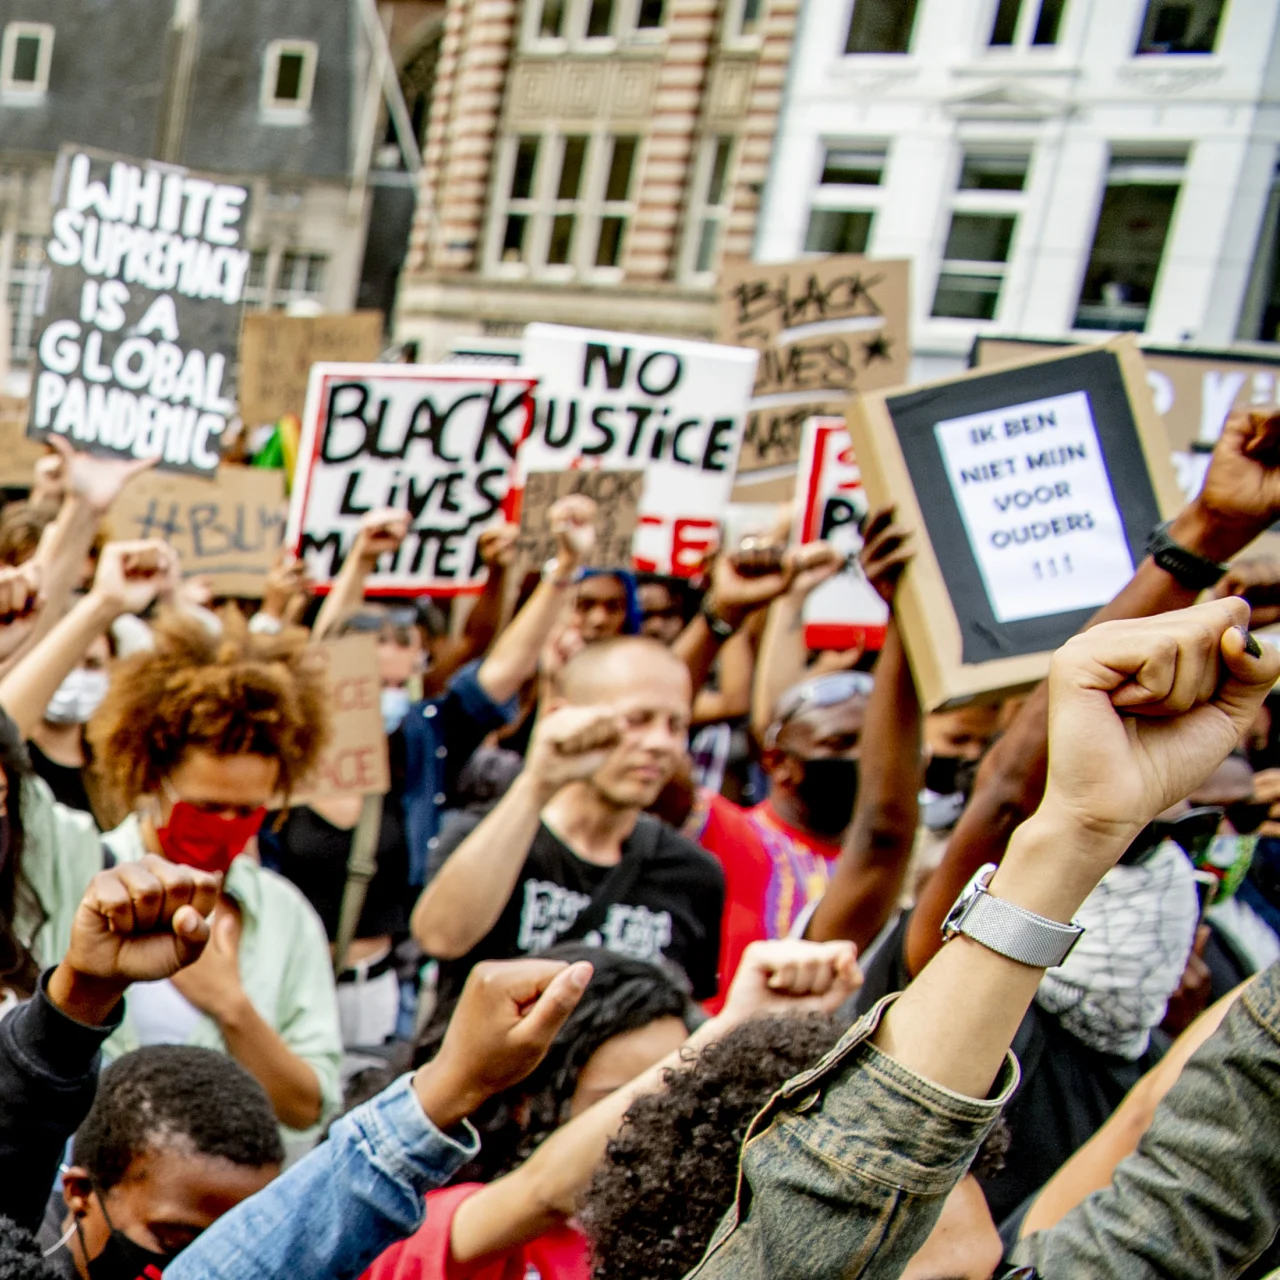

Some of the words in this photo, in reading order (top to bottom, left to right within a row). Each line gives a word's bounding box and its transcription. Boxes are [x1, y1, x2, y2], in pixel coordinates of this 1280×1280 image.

[67, 153, 248, 246] WHITE
[47, 208, 251, 305] SUPREMACY
[80, 279, 131, 333] IS
[130, 294, 181, 342] A
[733, 273, 888, 327] BLACK
[39, 319, 240, 416] GLOBAL
[582, 342, 683, 397] NO
[34, 371, 228, 470] PANDEMIC
[321, 381, 535, 464] BLACK
[970, 425, 996, 446] IK
[1003, 411, 1057, 438] BEN
[960, 457, 1017, 485] NIET
[1026, 443, 1088, 470] MIJN
[993, 481, 1072, 512] VOOR
[990, 511, 1095, 550] OUDERS
